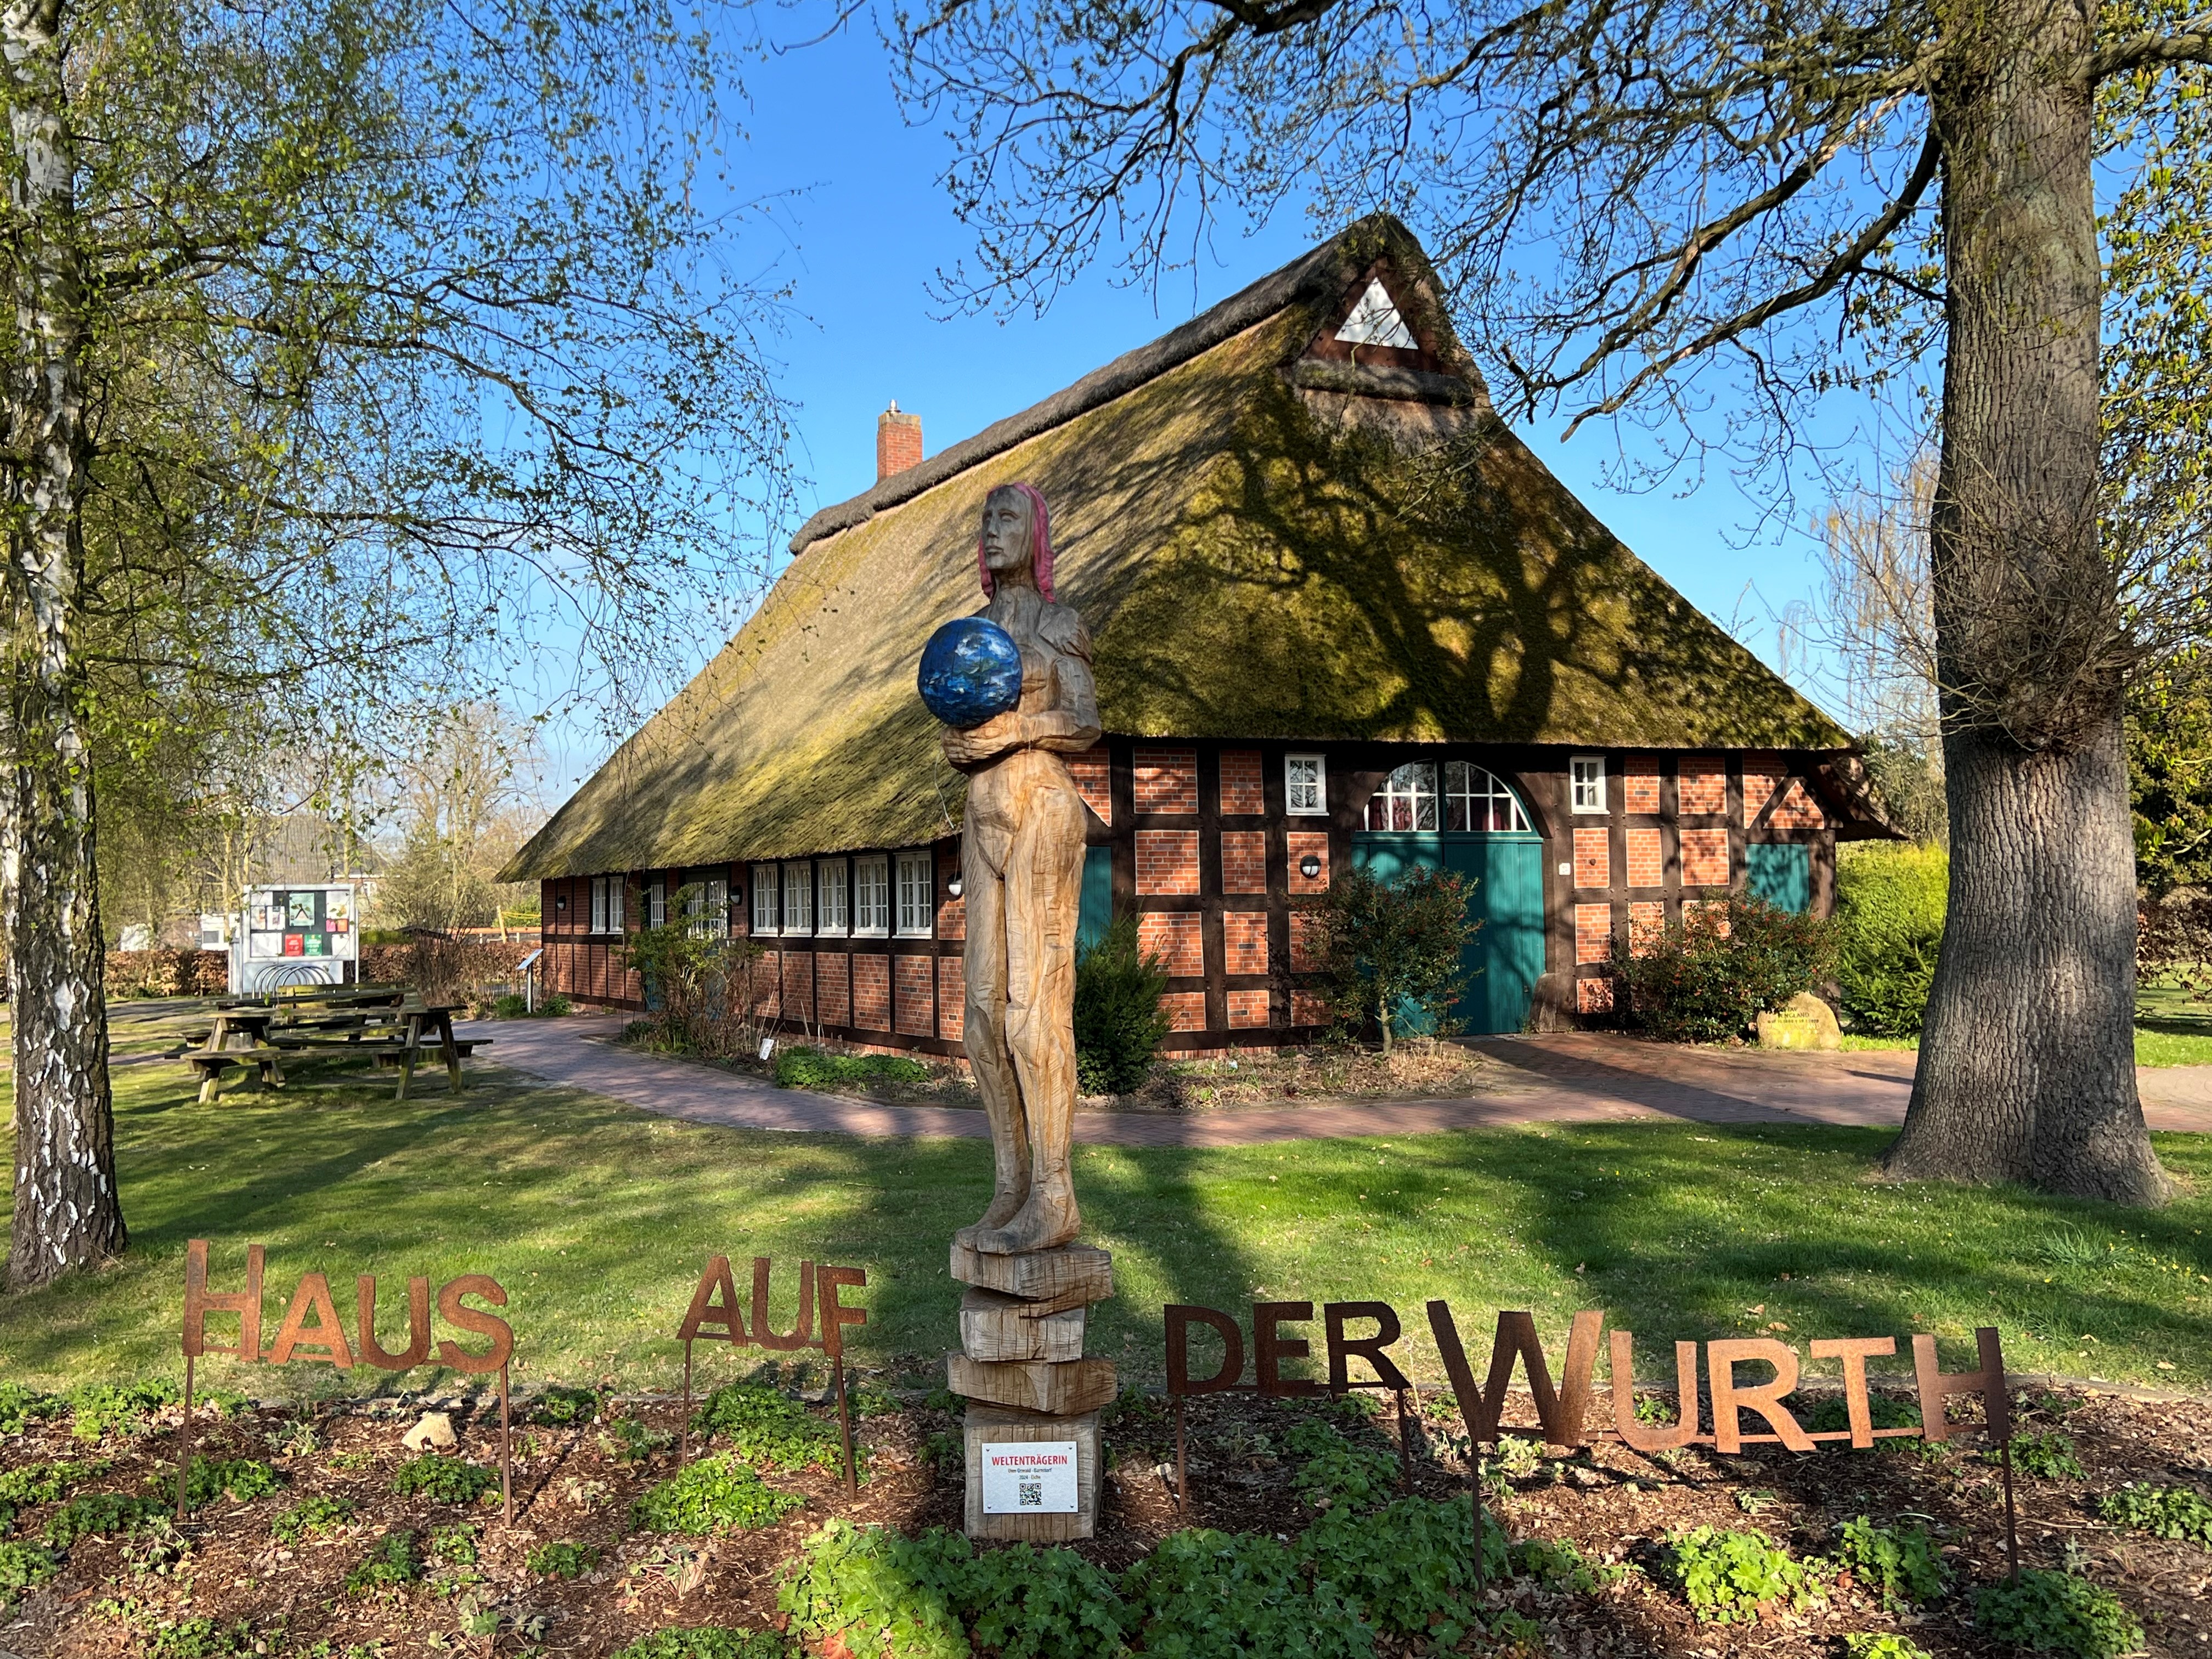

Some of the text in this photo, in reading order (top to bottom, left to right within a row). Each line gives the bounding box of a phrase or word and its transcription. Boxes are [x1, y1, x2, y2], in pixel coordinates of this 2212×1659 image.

[183, 1239, 2008, 1453] HAUS AUF DER WURTH
[992, 1454, 1068, 1466] WELTENTRÄGERIN
